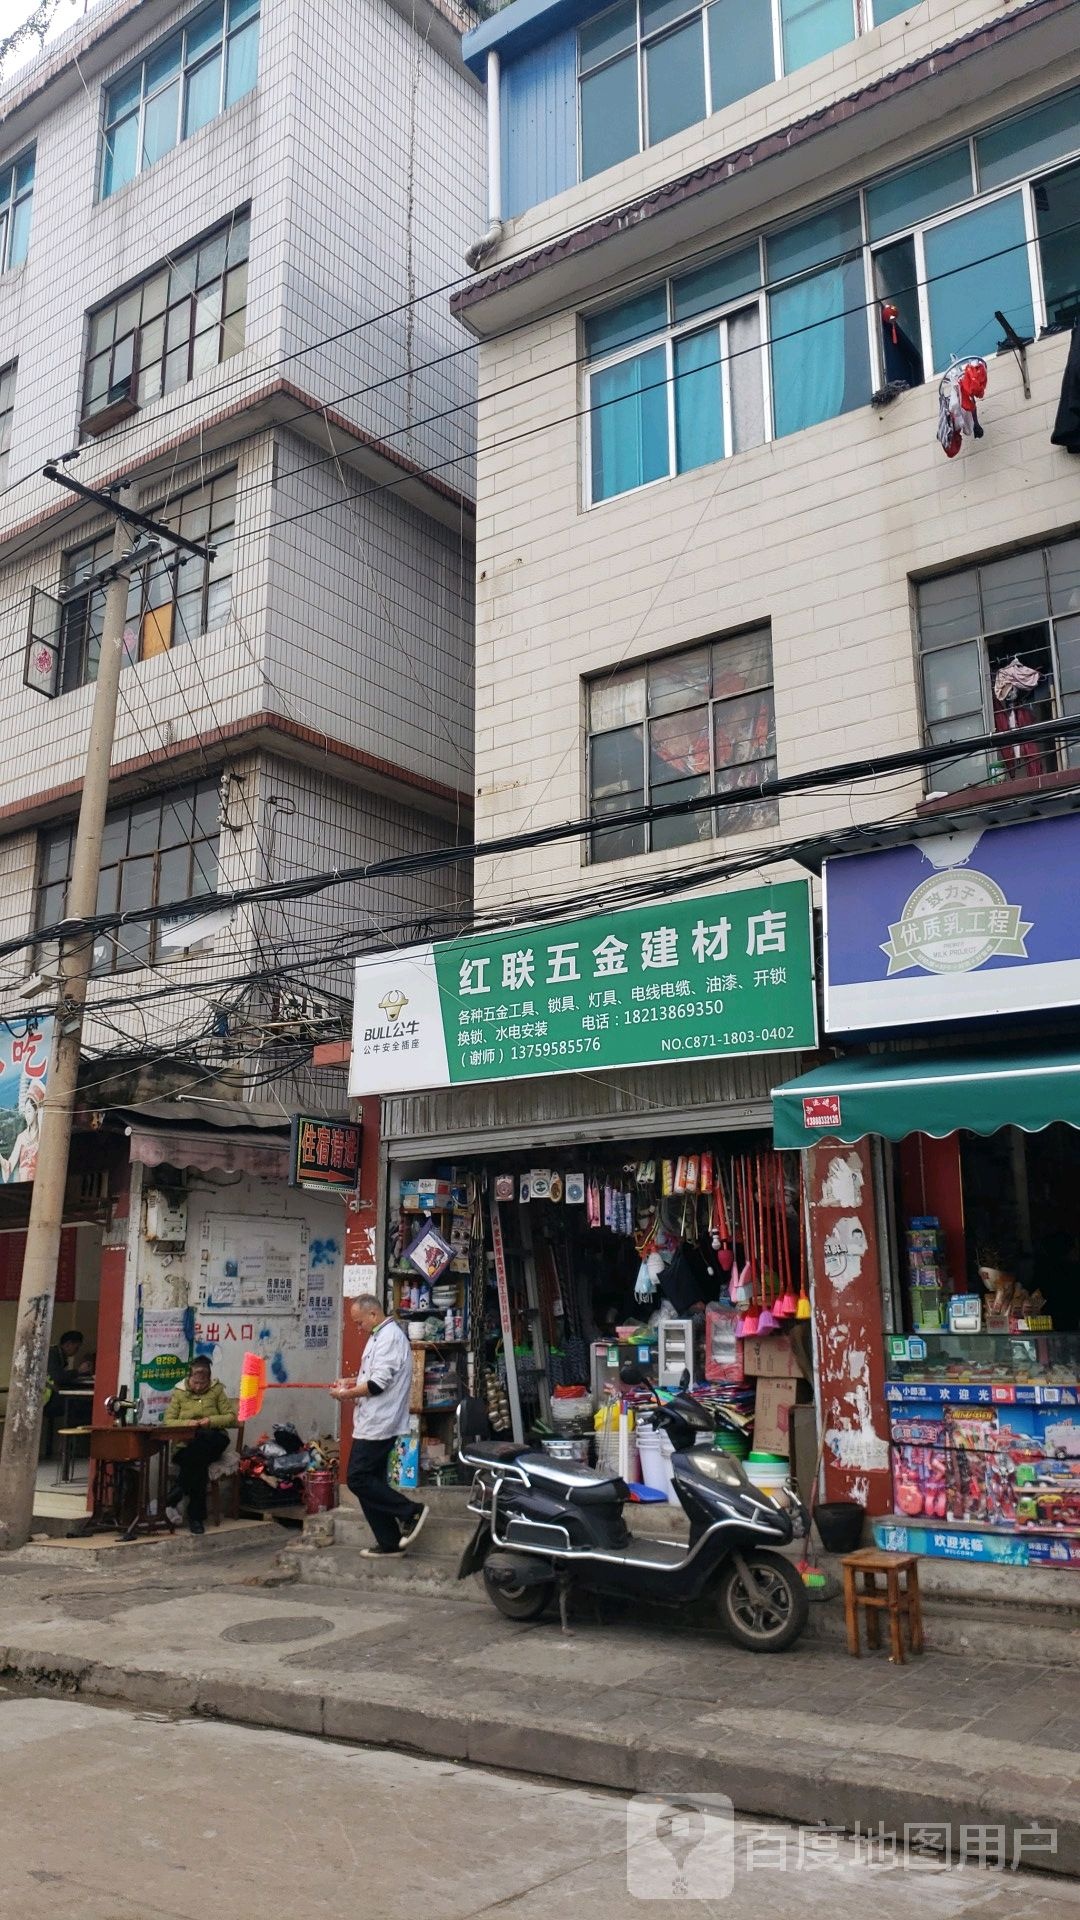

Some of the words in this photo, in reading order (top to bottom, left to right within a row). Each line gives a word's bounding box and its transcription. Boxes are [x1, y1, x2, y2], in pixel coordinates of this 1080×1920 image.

[925, 885, 976, 909] 致力于
[900, 911, 1010, 946] 优质乳工程
[458, 909, 788, 996] 红联五金建材店
[457, 966, 787, 1025] 各种五金工具、锁具、灯具、电线电缆、油漆、开锁
[364, 1020, 419, 1041] BULL公牛
[457, 1021, 548, 1046] 换锁、水电安装
[661, 1026, 795, 1052] NO.C871-1803-0402
[363, 1038, 420, 1055] 公牛安全插座
[302, 1123, 357, 1168] 住宿请进
[934, 1534, 984, 1552] 欢迎光临
